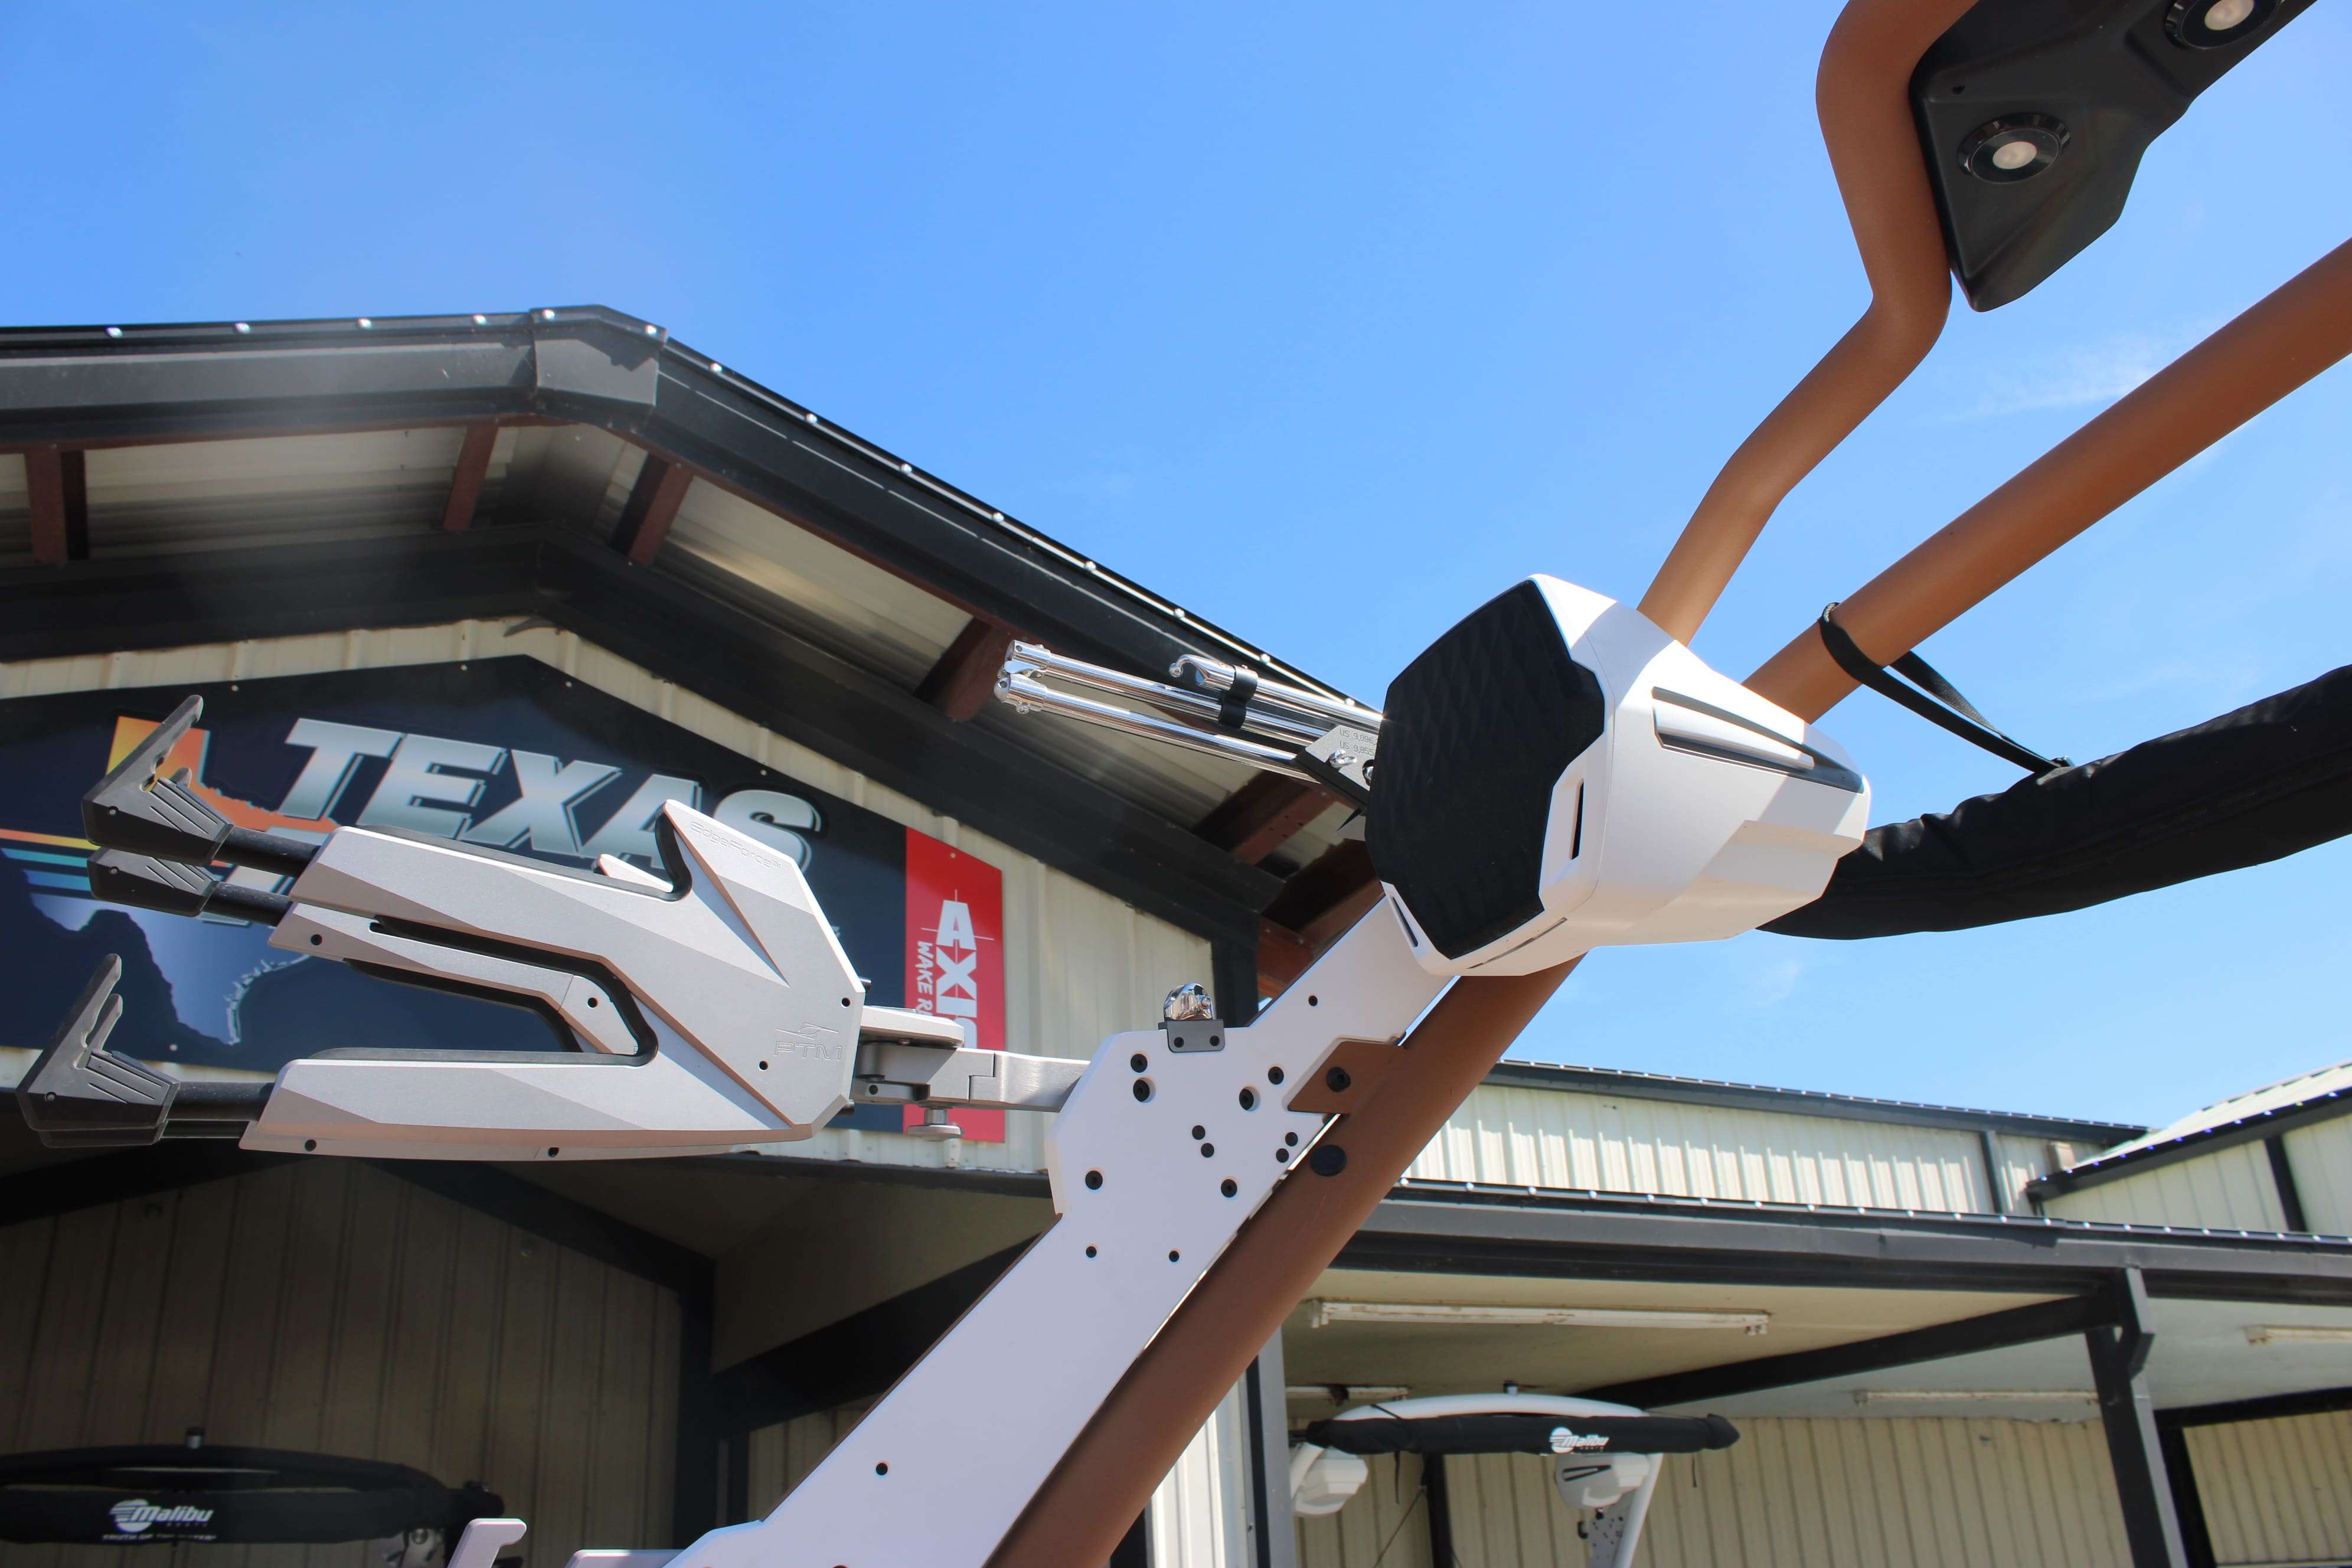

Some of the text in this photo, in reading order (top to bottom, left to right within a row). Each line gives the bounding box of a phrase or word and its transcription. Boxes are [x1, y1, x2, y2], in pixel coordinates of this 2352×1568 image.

[1340, 727, 1350, 738] US
[1340, 741, 1350, 750] US
[277, 717, 821, 873] TEXAS
[915, 940, 934, 995] WAKE
[130, 1506, 214, 1522] Malibu
